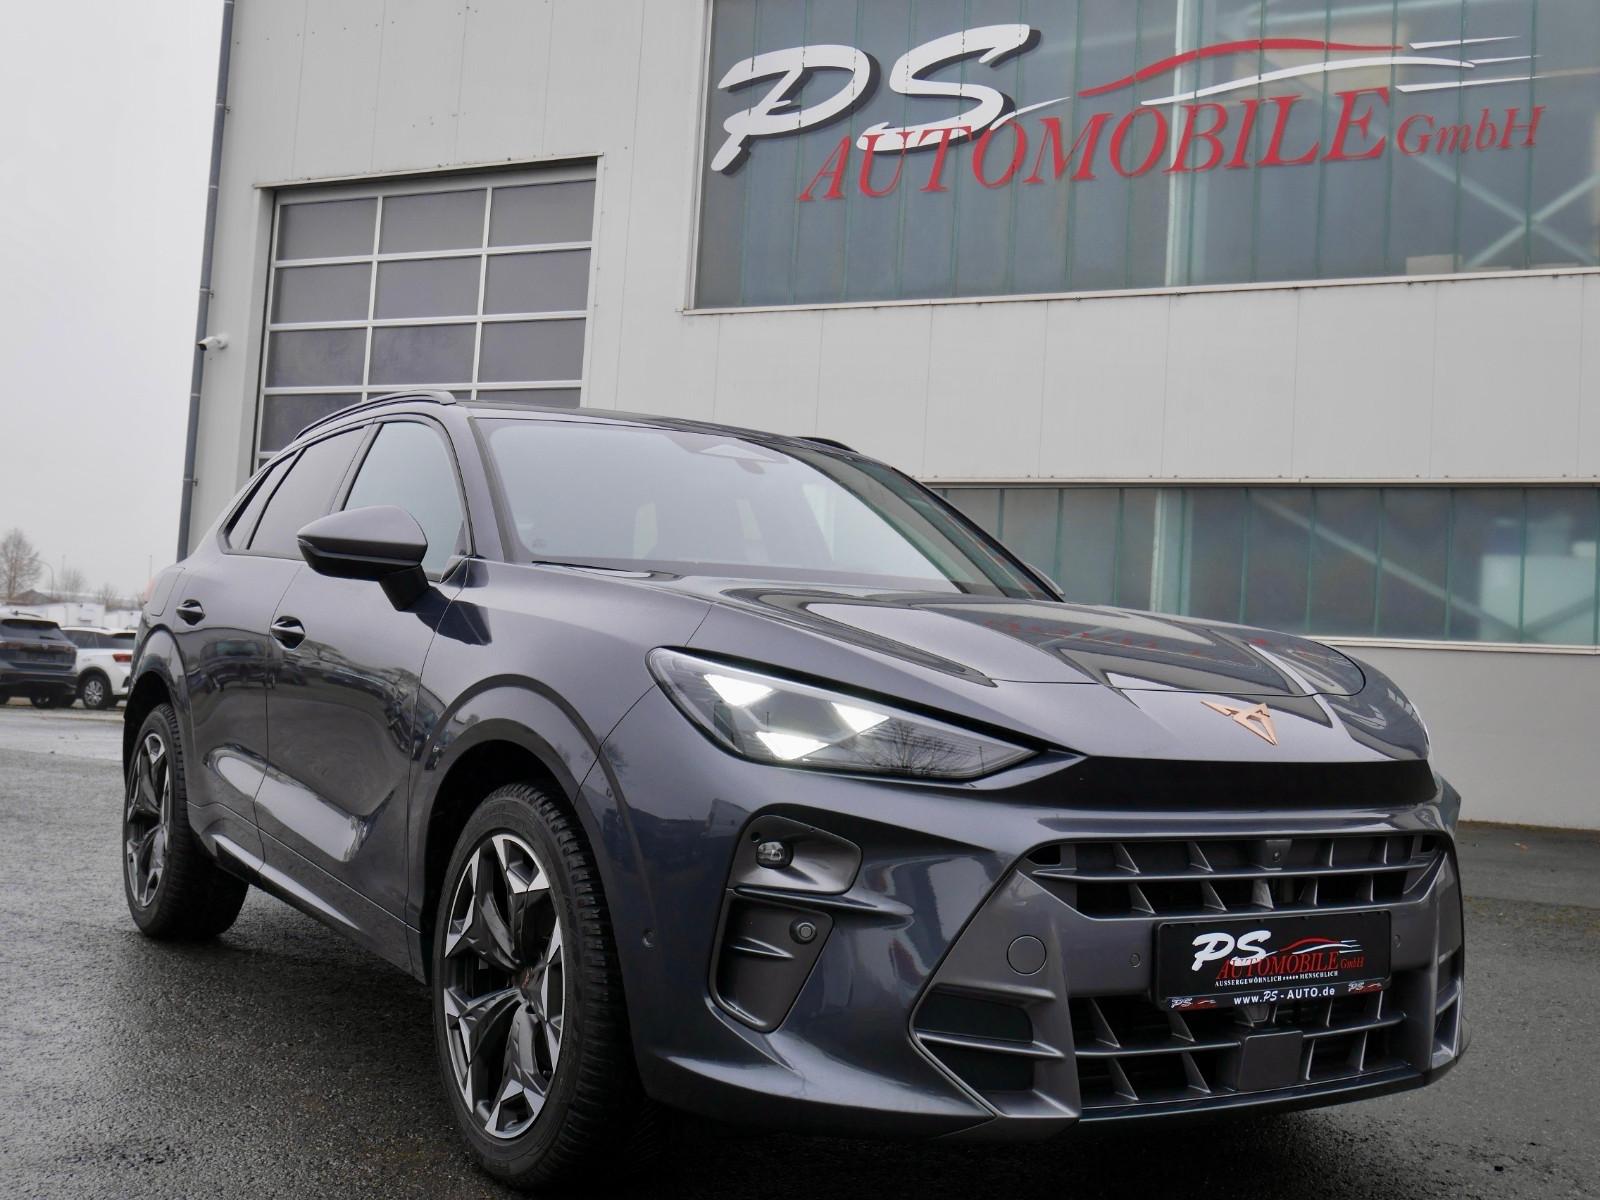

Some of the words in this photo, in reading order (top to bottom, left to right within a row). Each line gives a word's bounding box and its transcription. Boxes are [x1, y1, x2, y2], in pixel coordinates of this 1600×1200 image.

[710, 23, 1038, 174] PS
[797, 86, 1391, 202] AUTOMOBILE
[1396, 104, 1547, 157] GmbH
[1191, 930, 1272, 971] PS
[1216, 951, 1339, 980] AUTOMOBILE
[1340, 955, 1364, 969] GmbH
[1215, 975, 1282, 987] AUSSERGEWÖHNLICH
[1299, 970, 1339, 980] MENSCHLICH
